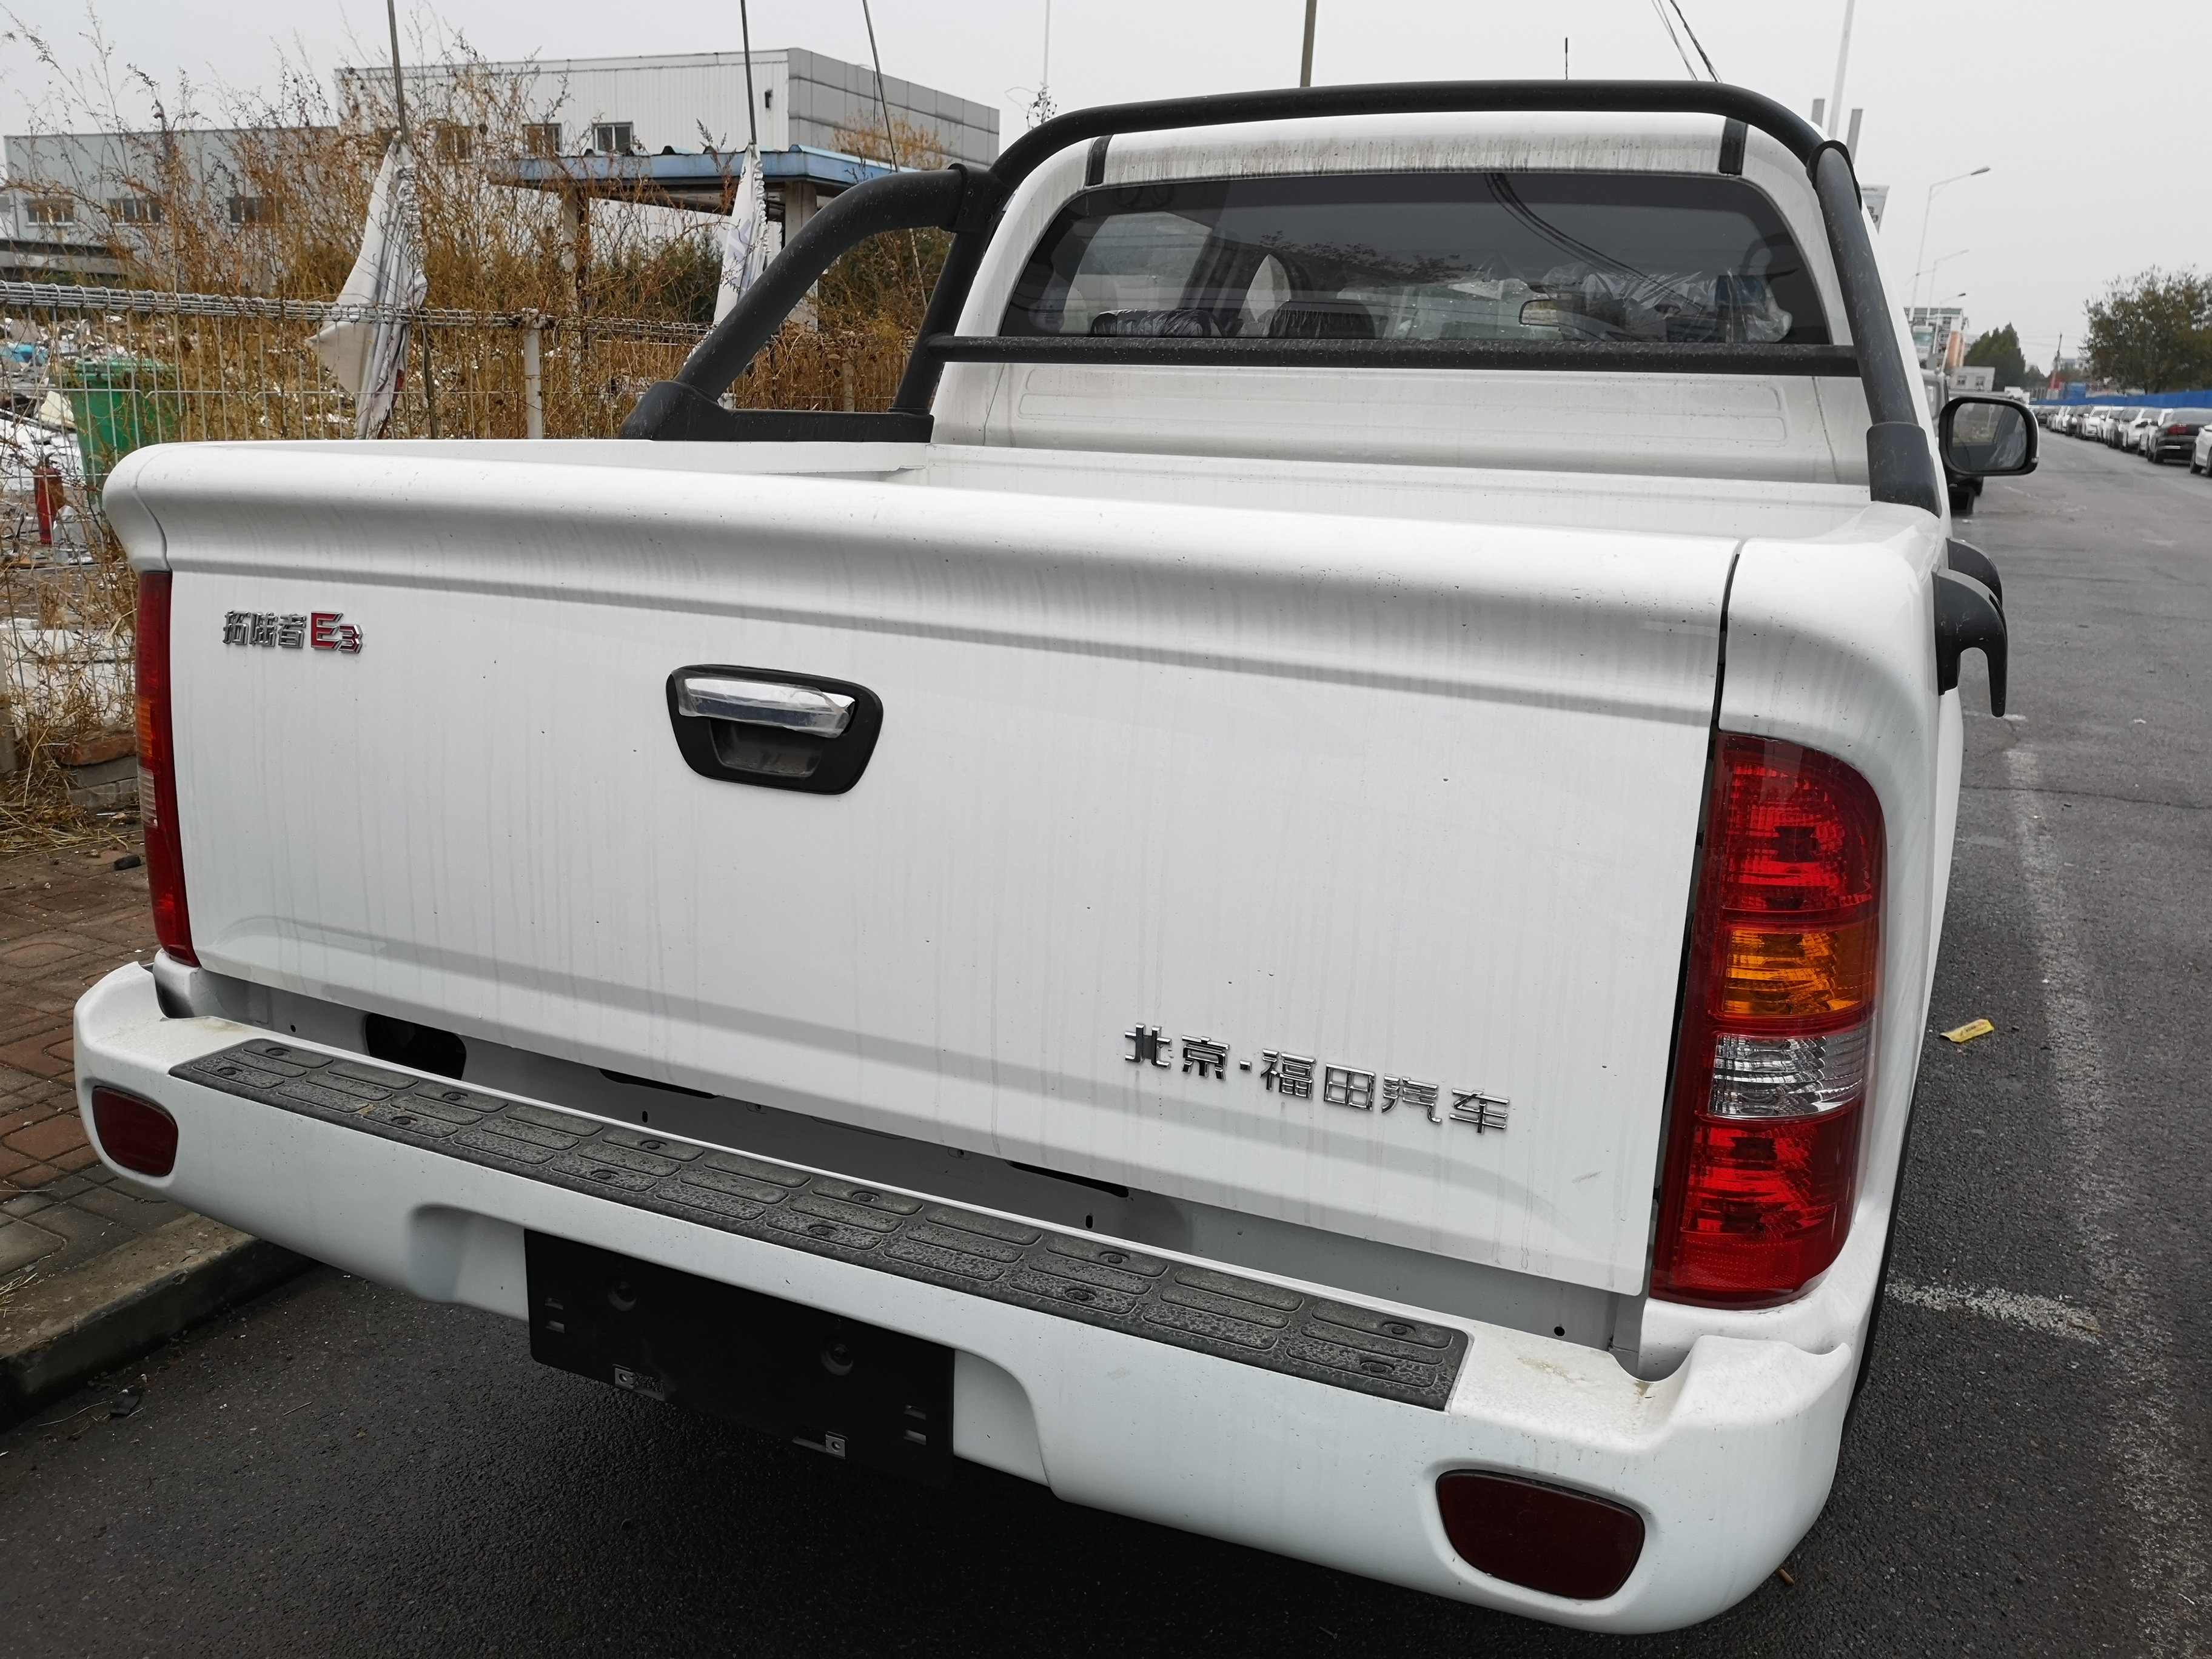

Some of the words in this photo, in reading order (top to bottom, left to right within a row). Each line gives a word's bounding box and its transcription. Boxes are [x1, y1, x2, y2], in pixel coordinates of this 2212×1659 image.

[310, 611, 363, 654] E3
[1125, 1022, 1510, 1134] 北京·福田汽车
